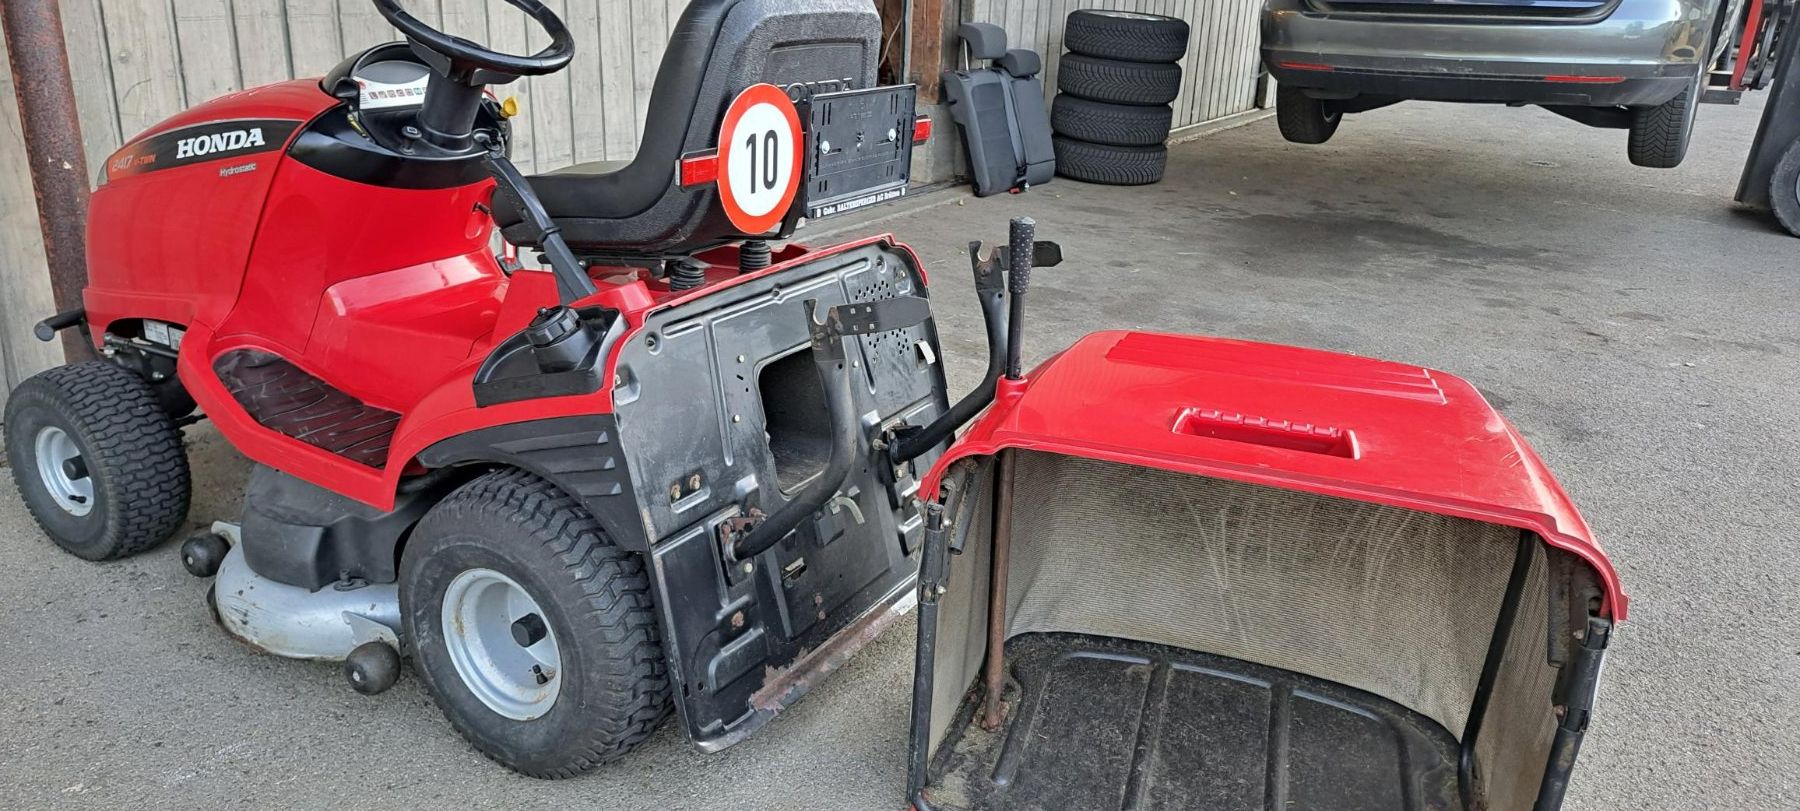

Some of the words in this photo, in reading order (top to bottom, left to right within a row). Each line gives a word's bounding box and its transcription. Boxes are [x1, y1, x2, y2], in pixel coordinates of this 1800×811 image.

[777, 78, 853, 103] ONDA
[176, 127, 266, 159] HONDA
[112, 155, 134, 171] 2417
[219, 162, 257, 177] Hydrostatic
[746, 129, 778, 194] 10
[877, 193, 884, 202] AG
